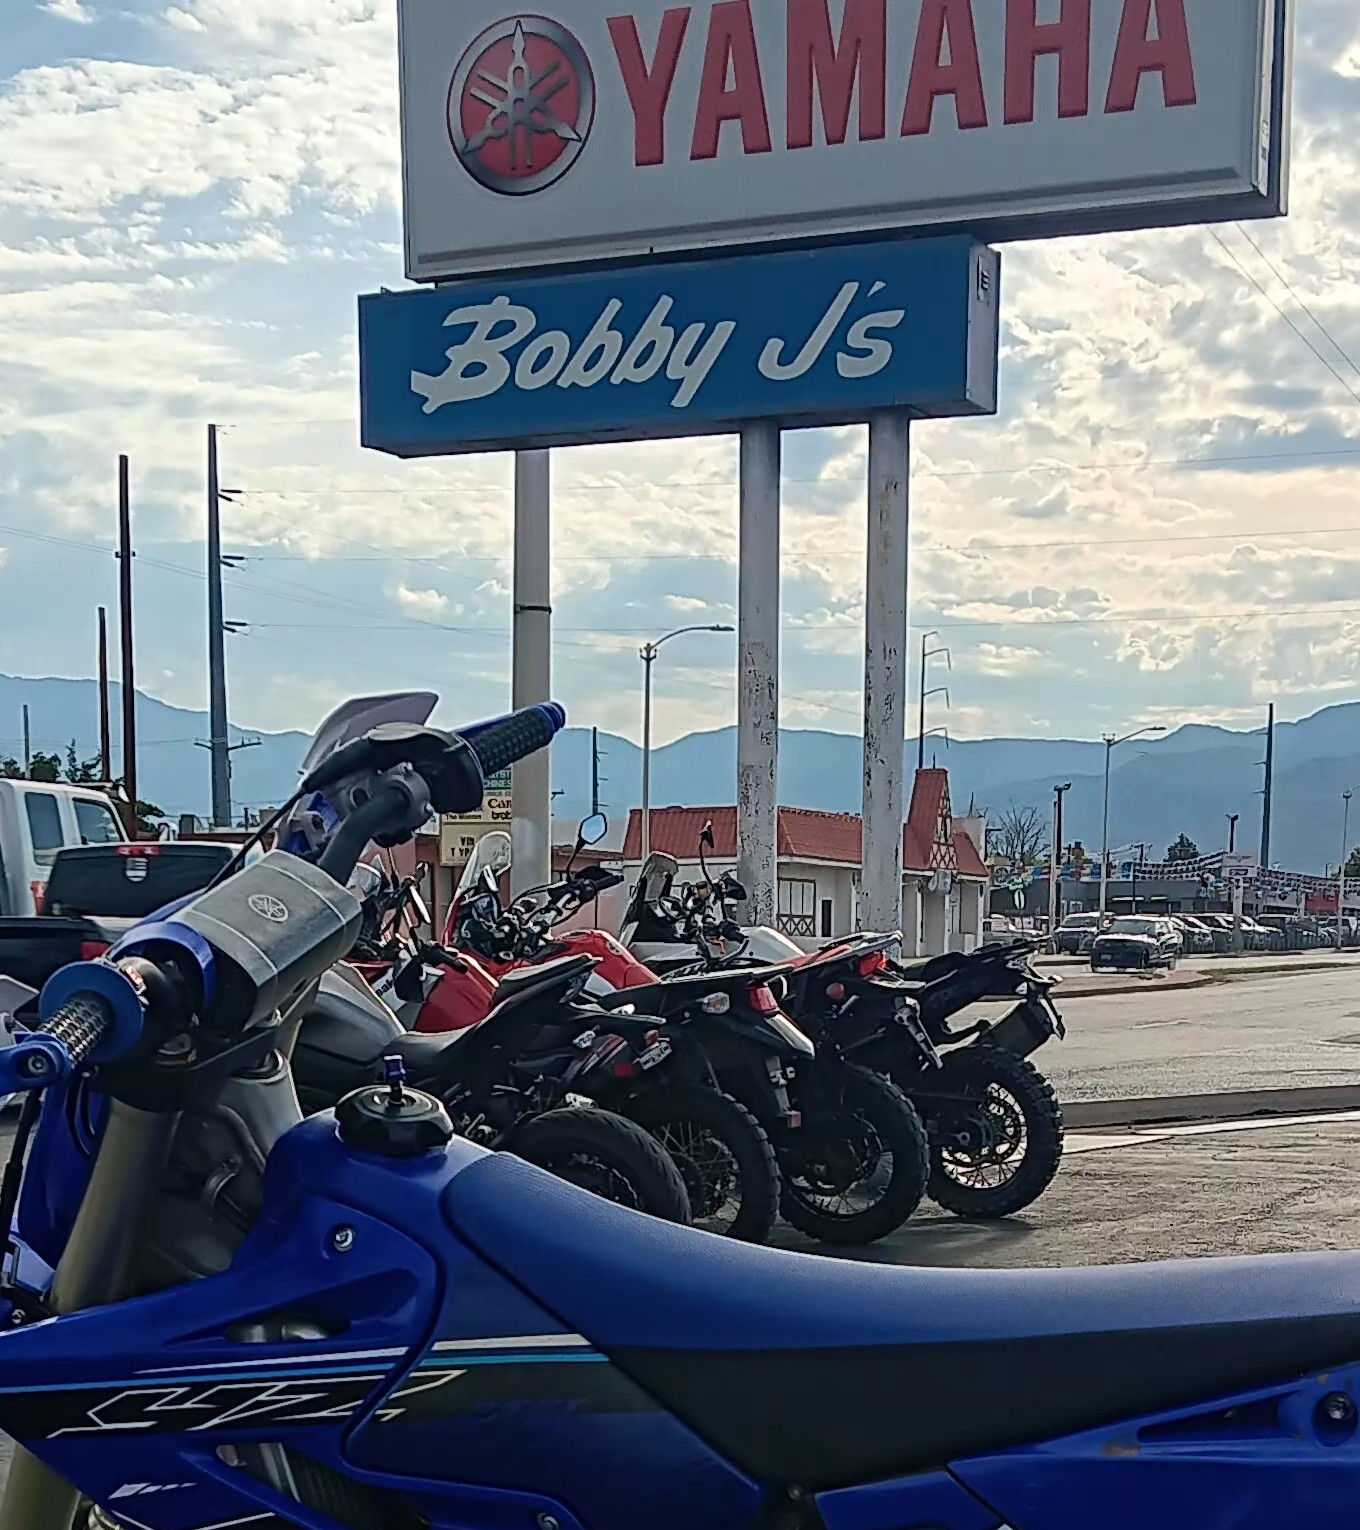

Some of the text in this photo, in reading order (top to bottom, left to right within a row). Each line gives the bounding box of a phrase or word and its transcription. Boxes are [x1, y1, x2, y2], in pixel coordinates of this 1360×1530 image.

[606, 0, 1197, 167] YAMAHA
[410, 281, 905, 410] Bobby J's
